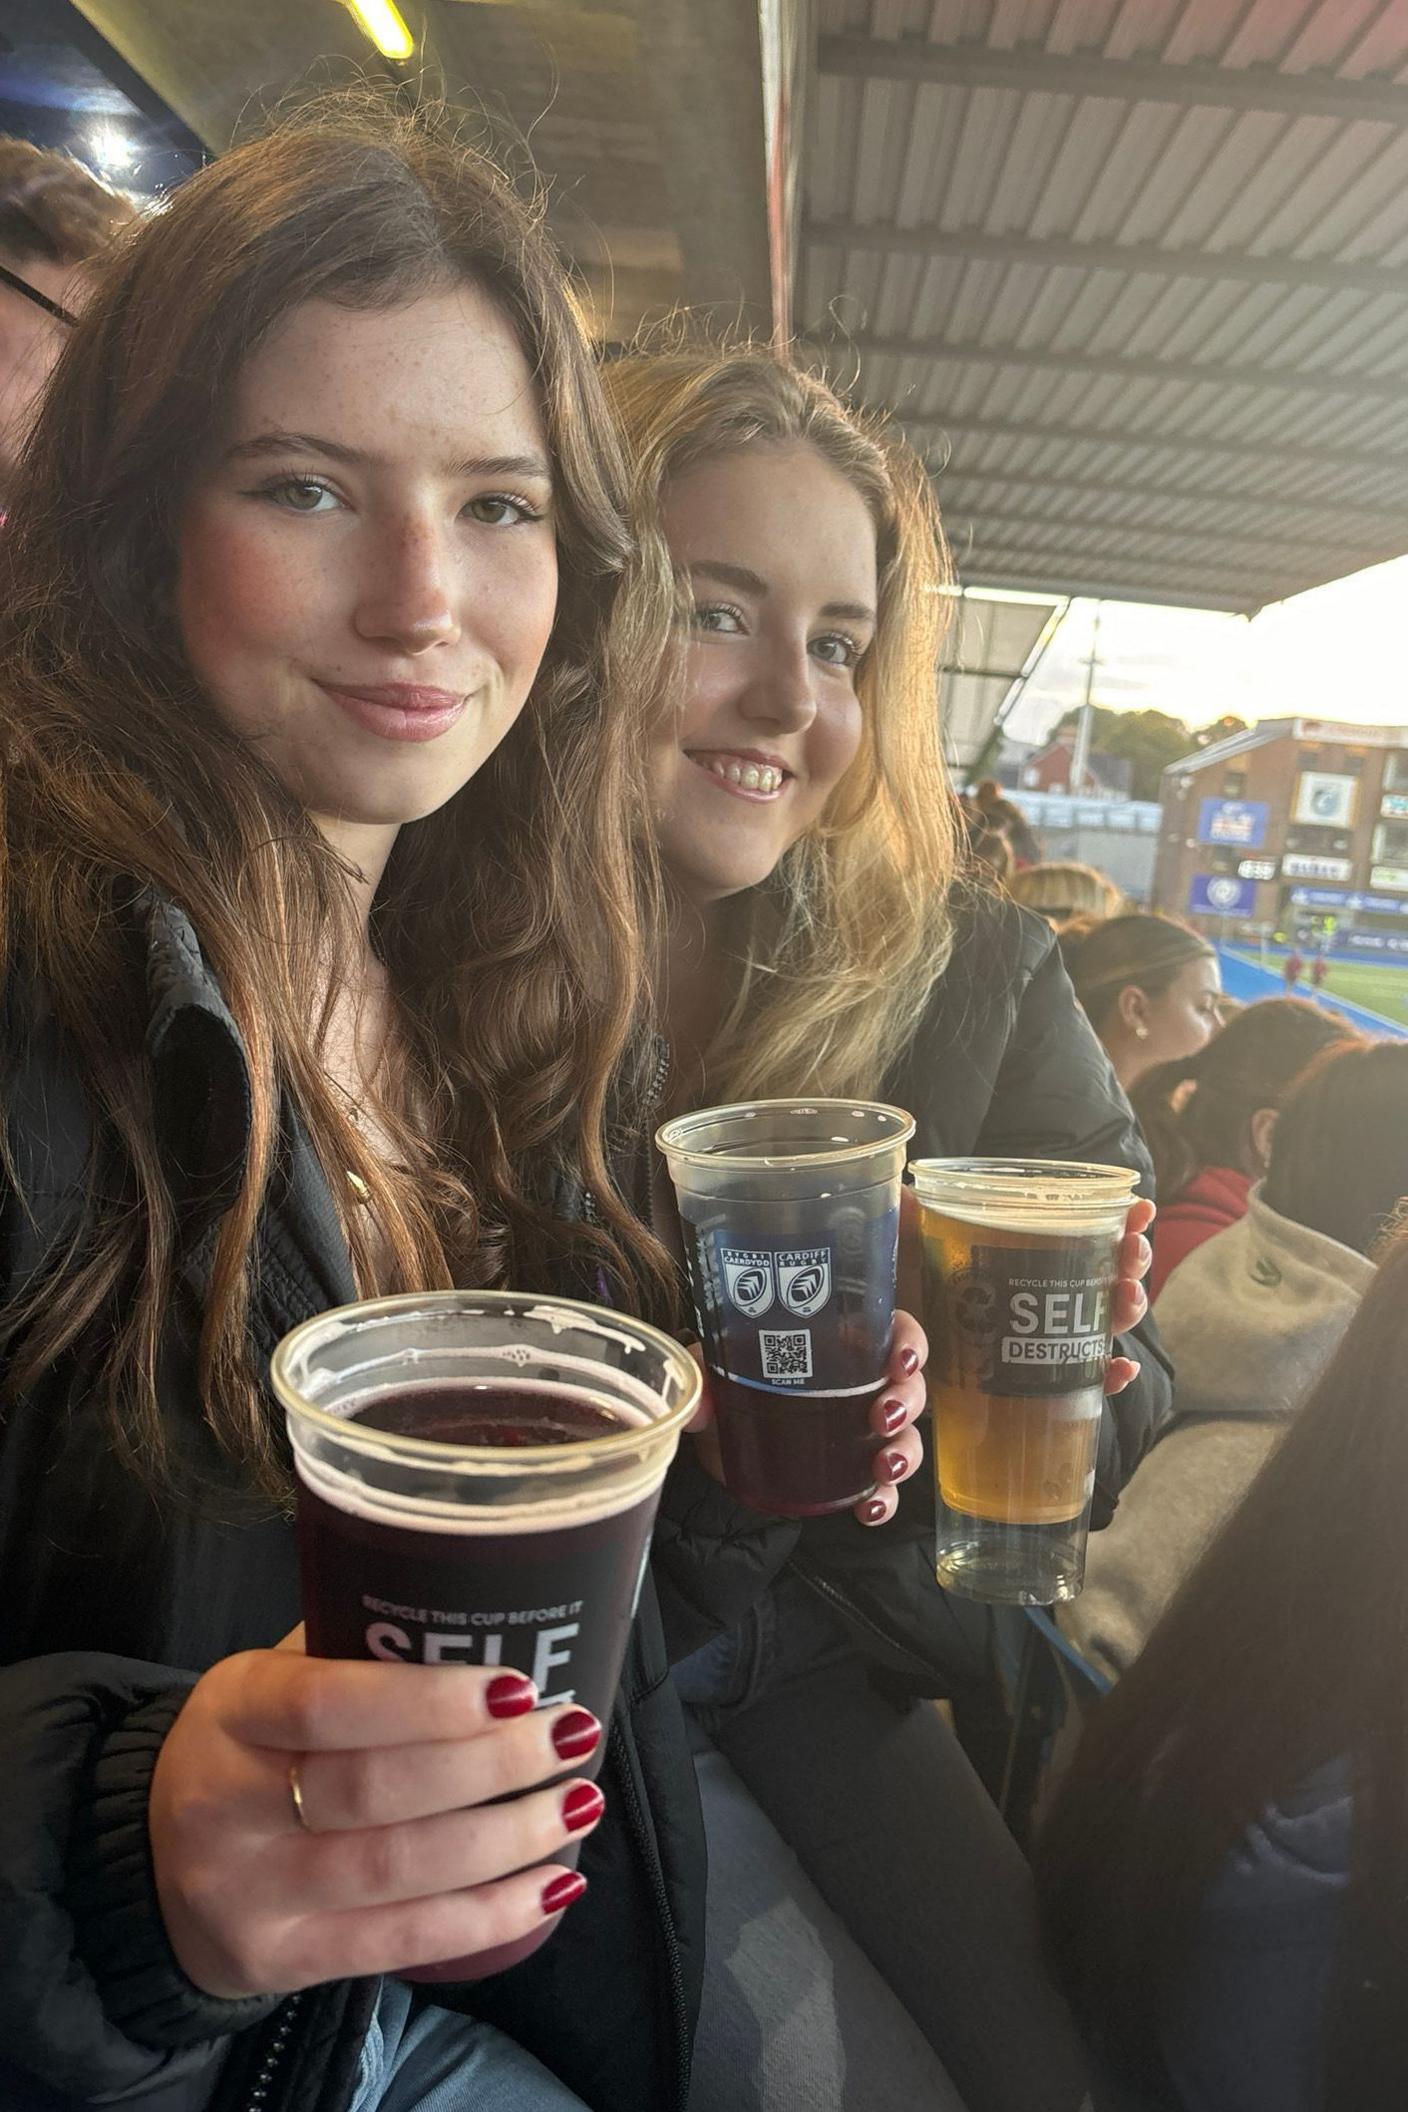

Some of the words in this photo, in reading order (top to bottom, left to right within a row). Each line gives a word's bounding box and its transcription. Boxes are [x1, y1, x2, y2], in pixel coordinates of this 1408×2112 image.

[779, 1250, 826, 1260] CARDIFF
[1009, 1278, 1048, 1287] RECYCLE
[1050, 1279, 1067, 1287] THIS
[1069, 1279, 1085, 1287] CUP
[1009, 1338, 1104, 1359] DESTRUCTS
[771, 1378, 792, 1386] SCAN
[362, 1594, 429, 1623] RECYCLE
[430, 1609, 467, 1625] THIS
[469, 1612, 506, 1626] CUP
[508, 1604, 567, 1625] BEFORE
[568, 1599, 584, 1615] IT
